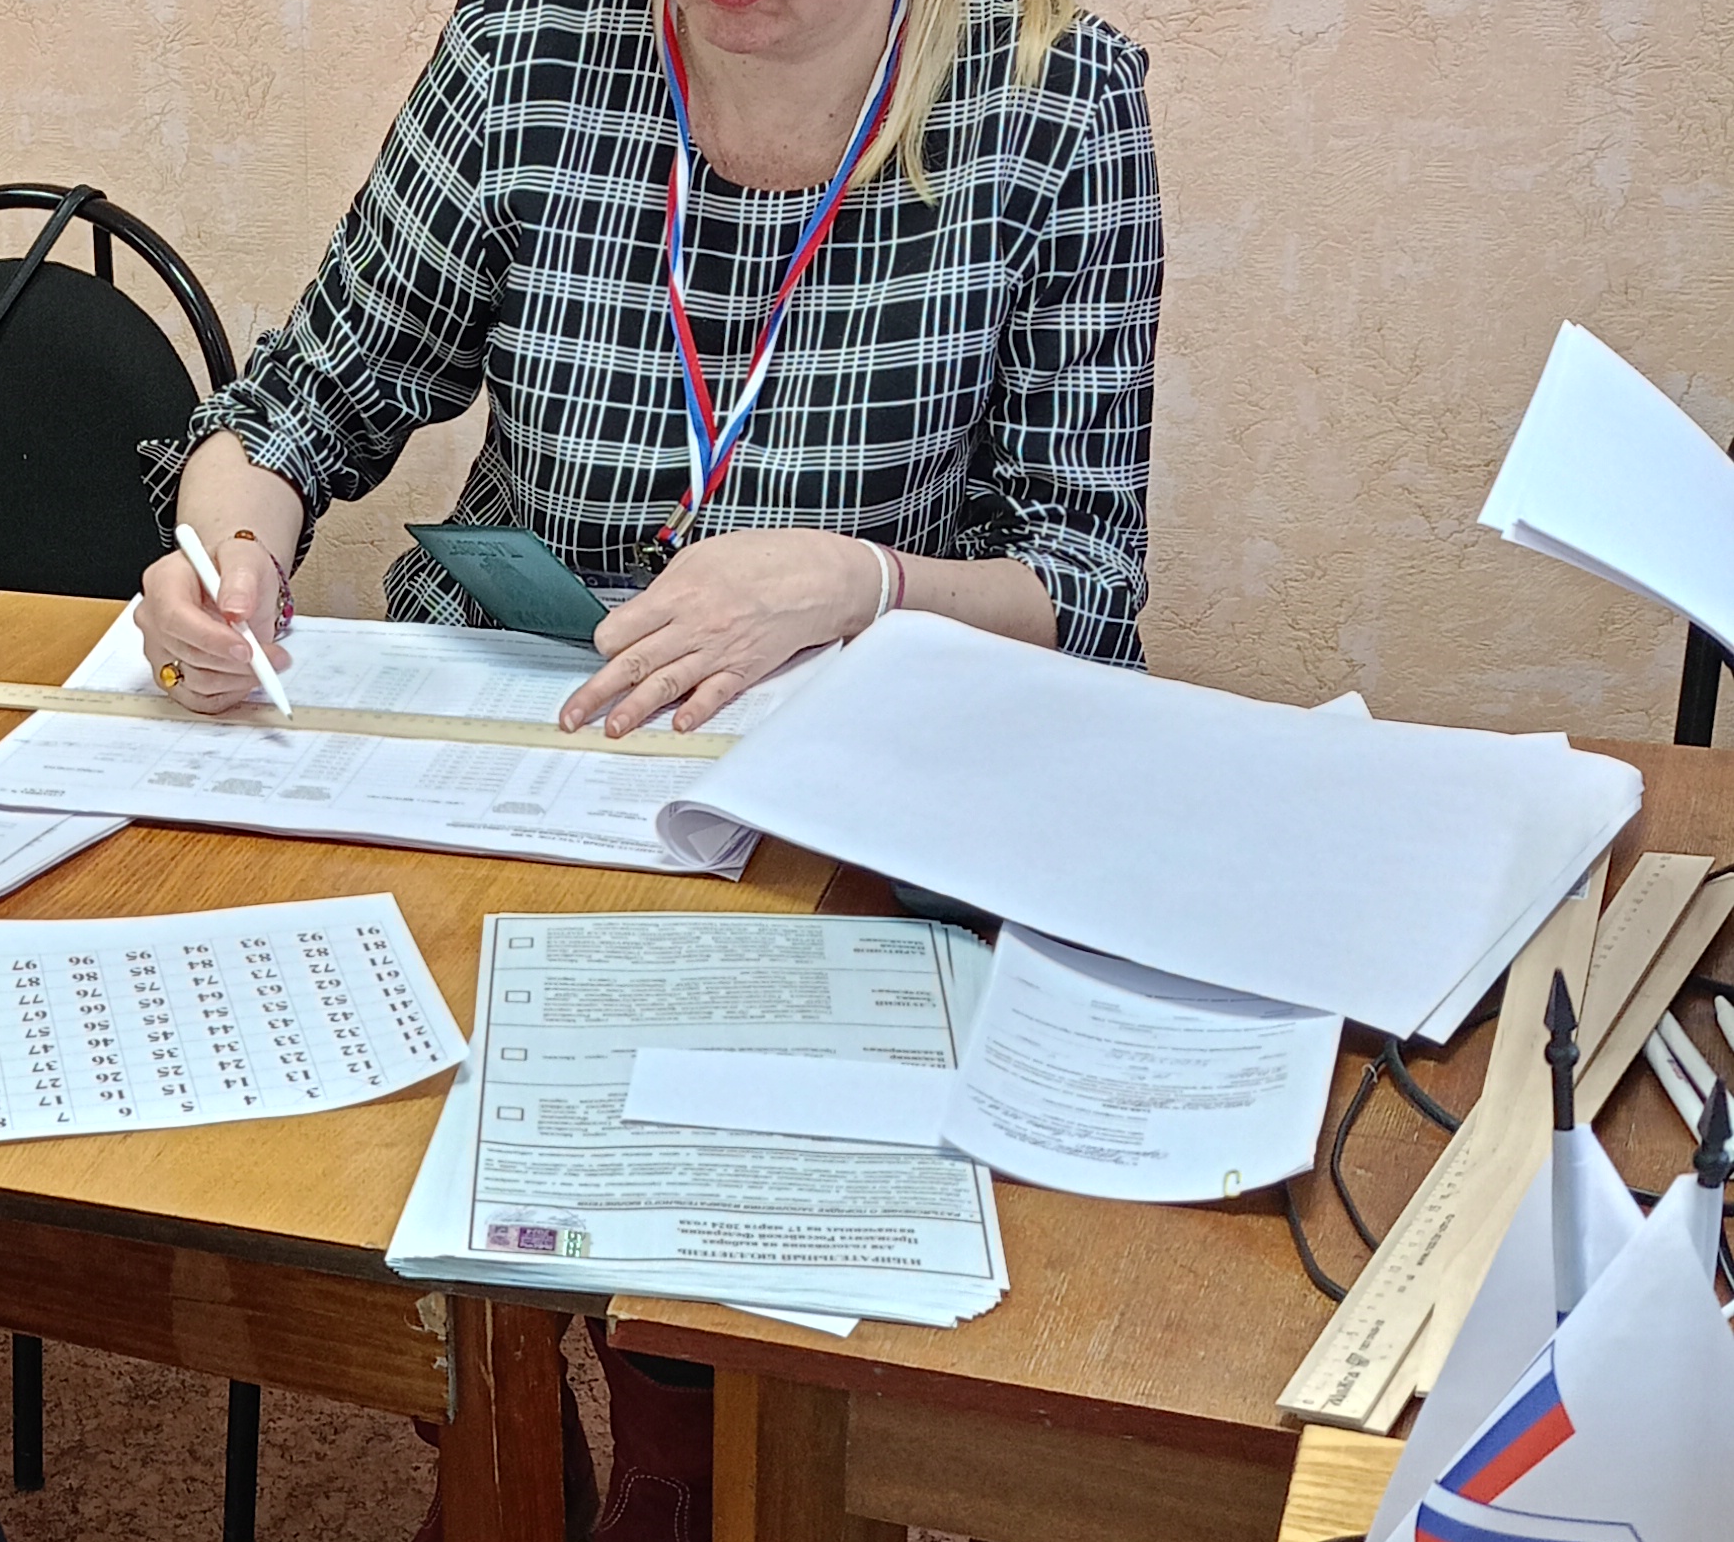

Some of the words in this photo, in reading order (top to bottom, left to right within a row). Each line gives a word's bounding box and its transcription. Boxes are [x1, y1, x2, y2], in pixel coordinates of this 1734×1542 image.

[356, 927, 381, 937] 91
[297, 933, 323, 943] 92
[240, 939, 266, 949] 93
[363, 940, 387, 952] 81
[183, 945, 209, 955] 94
[303, 947, 330, 958] 82
[68, 956, 95, 966] 96
[125, 951, 152, 961] 95
[245, 953, 272, 964] 83
[369, 955, 393, 967] 71
[12, 960, 37, 971] 97
[187, 959, 214, 970] 84
[309, 963, 336, 974] 72
[72, 971, 99, 982] 86
[129, 965, 156, 977] 85
[250, 968, 278, 980] 73
[15, 977, 41, 989] 87
[192, 975, 219, 987] 74
[134, 982, 161, 992] 75
[76, 988, 103, 998] 76
[18, 994, 44, 1006] 77
